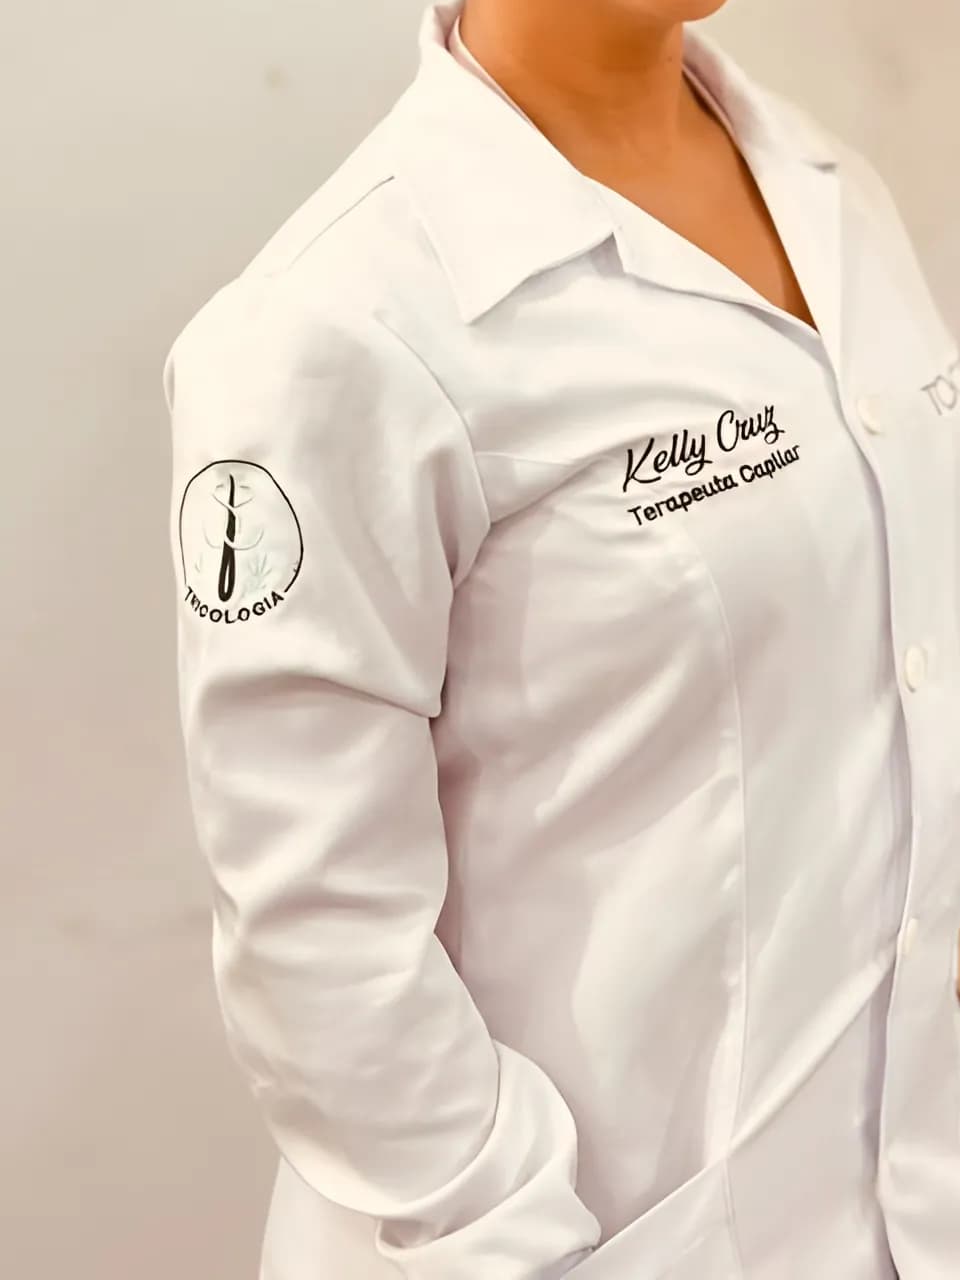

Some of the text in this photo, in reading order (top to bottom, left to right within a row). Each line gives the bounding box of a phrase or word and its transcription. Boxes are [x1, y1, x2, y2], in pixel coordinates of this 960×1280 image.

[622, 405, 785, 492] Kelly Cruz
[627, 474, 739, 526] Terapeuta
